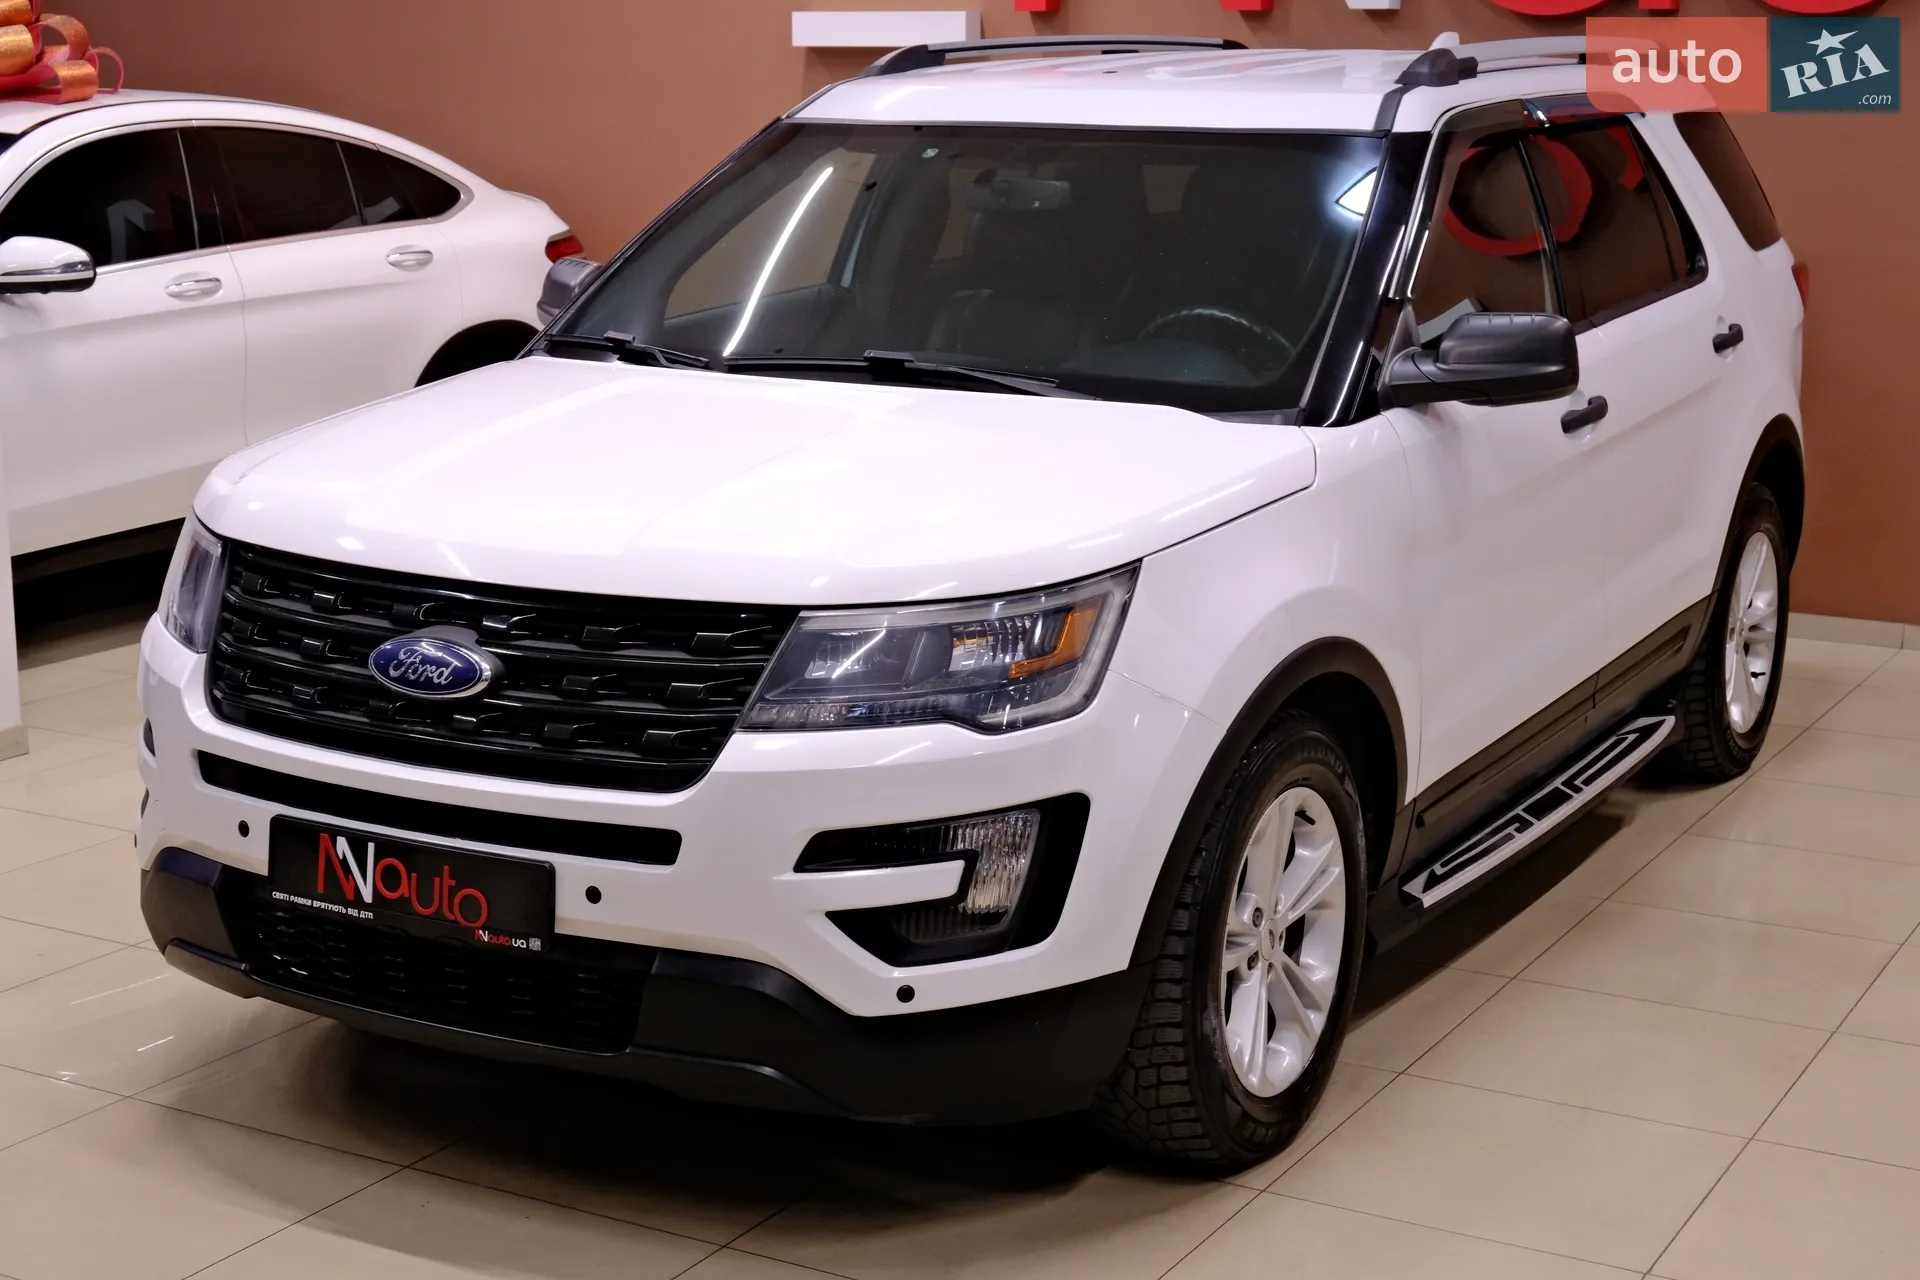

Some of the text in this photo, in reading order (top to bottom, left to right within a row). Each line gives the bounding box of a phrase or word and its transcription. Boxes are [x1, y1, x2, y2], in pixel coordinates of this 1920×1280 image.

[388, 646, 457, 685] Ford
[290, 895, 312, 907] РАМКИ
[313, 900, 347, 914] ВРЯТУЮТЬ
[347, 908, 359, 918] ВІД
[360, 910, 374, 920] ДТП
